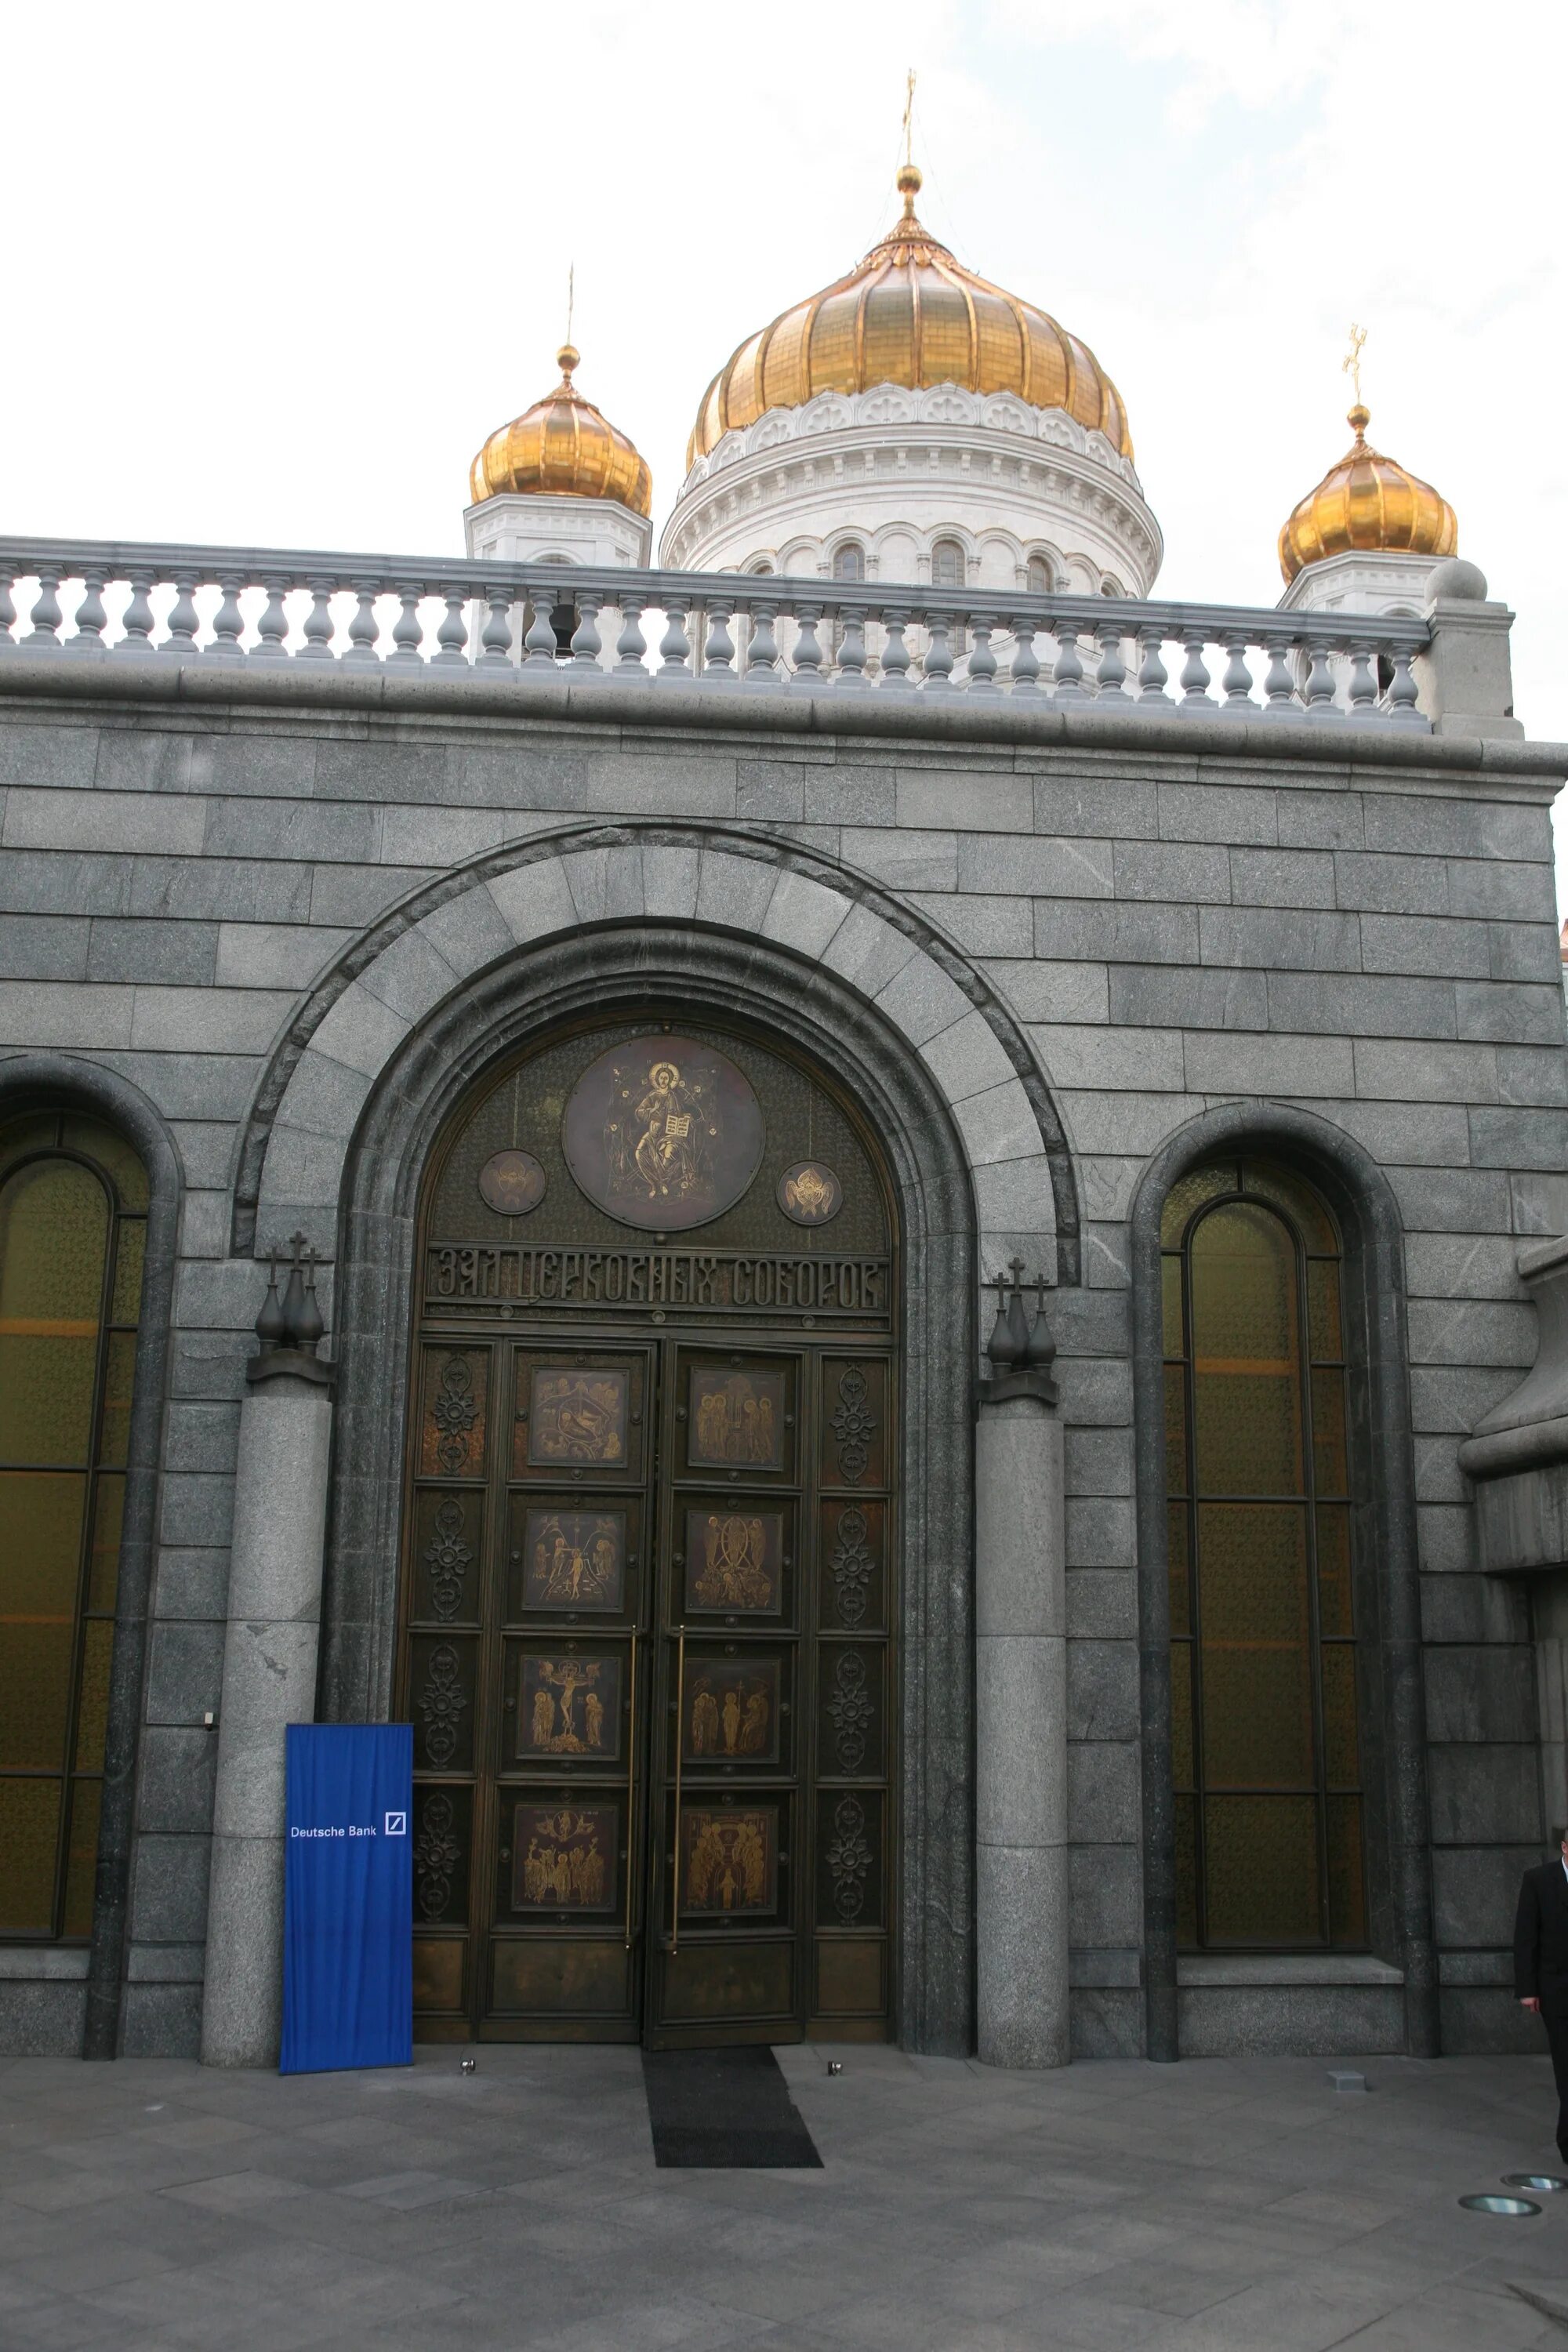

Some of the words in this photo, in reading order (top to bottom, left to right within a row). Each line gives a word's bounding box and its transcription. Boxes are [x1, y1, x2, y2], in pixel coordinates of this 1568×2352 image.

[437, 1248, 501, 1298] ЗАЛ
[517, 1250, 718, 1305] ЦЕРКОВНЫХ
[732, 1258, 879, 1308] СОБОРОВ
[291, 1826, 345, 1838] Deutsche
[349, 1824, 377, 1837] Bank
